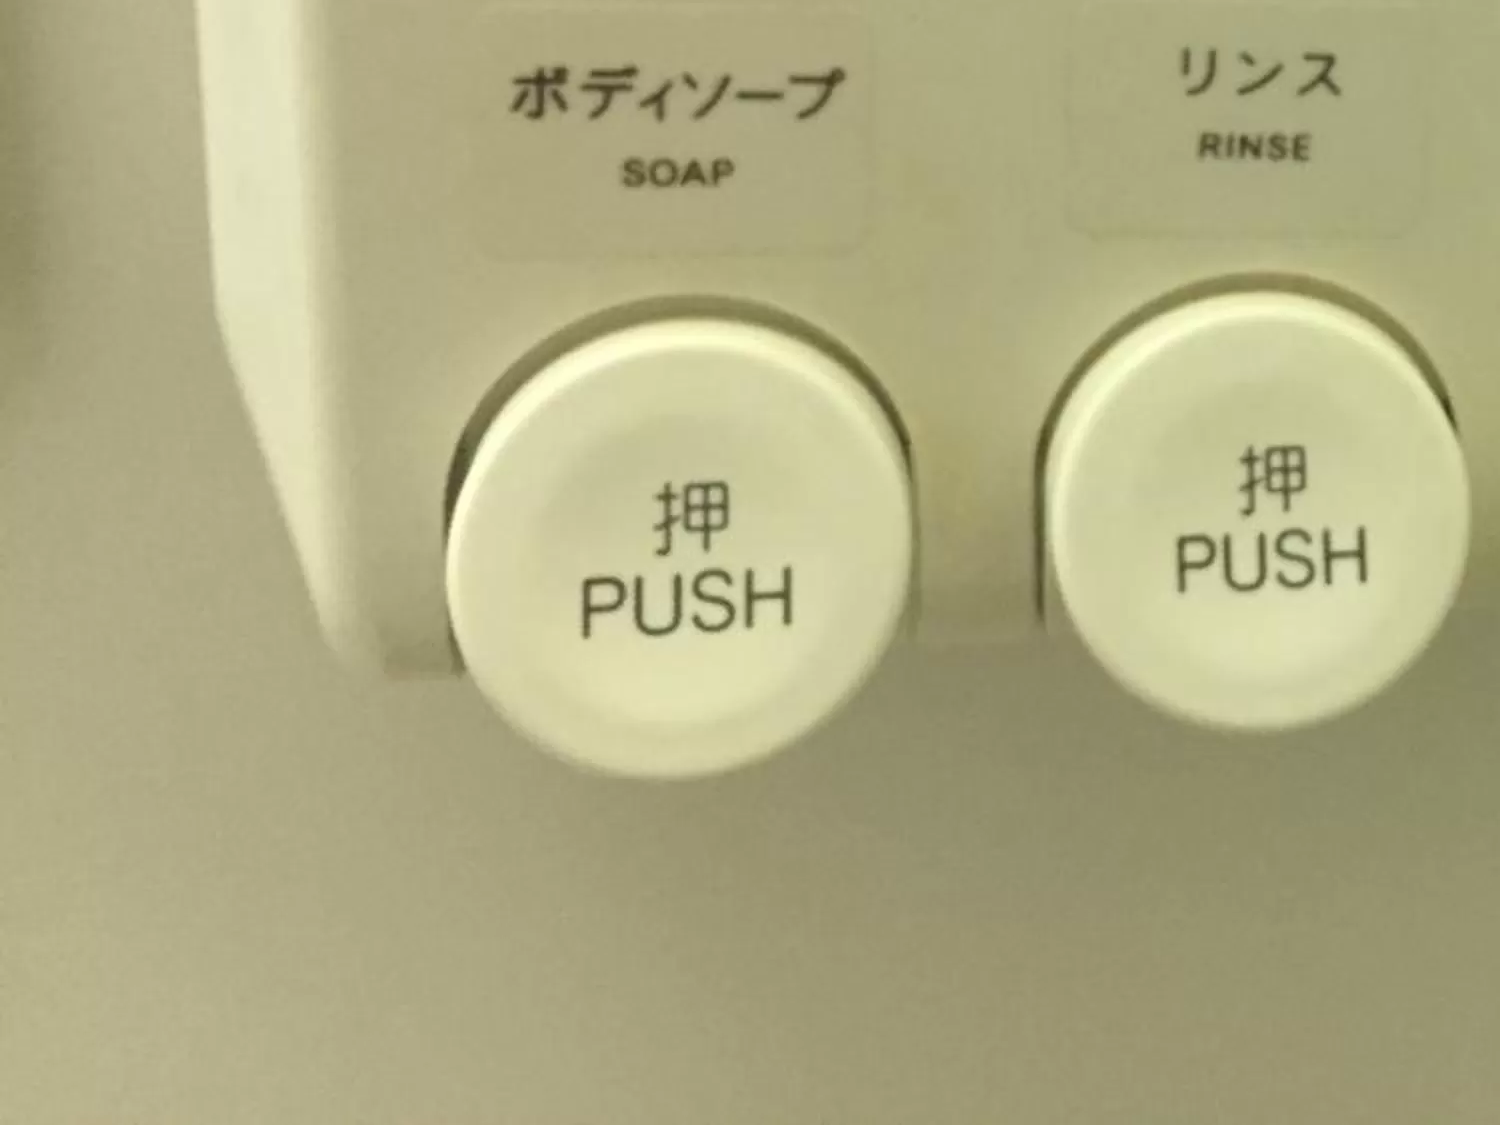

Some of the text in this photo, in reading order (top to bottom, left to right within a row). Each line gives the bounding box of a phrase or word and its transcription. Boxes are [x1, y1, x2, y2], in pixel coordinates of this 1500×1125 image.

[509, 64, 847, 123] ボディソープ
[1178, 45, 1344, 98] リンス
[621, 156, 736, 189] SOAP
[1197, 131, 1311, 163] RINSE
[1238, 443, 1308, 517] 押
[652, 480, 731, 557] 押
[1175, 527, 1369, 593] PUSH
[580, 567, 794, 639] PUSH
